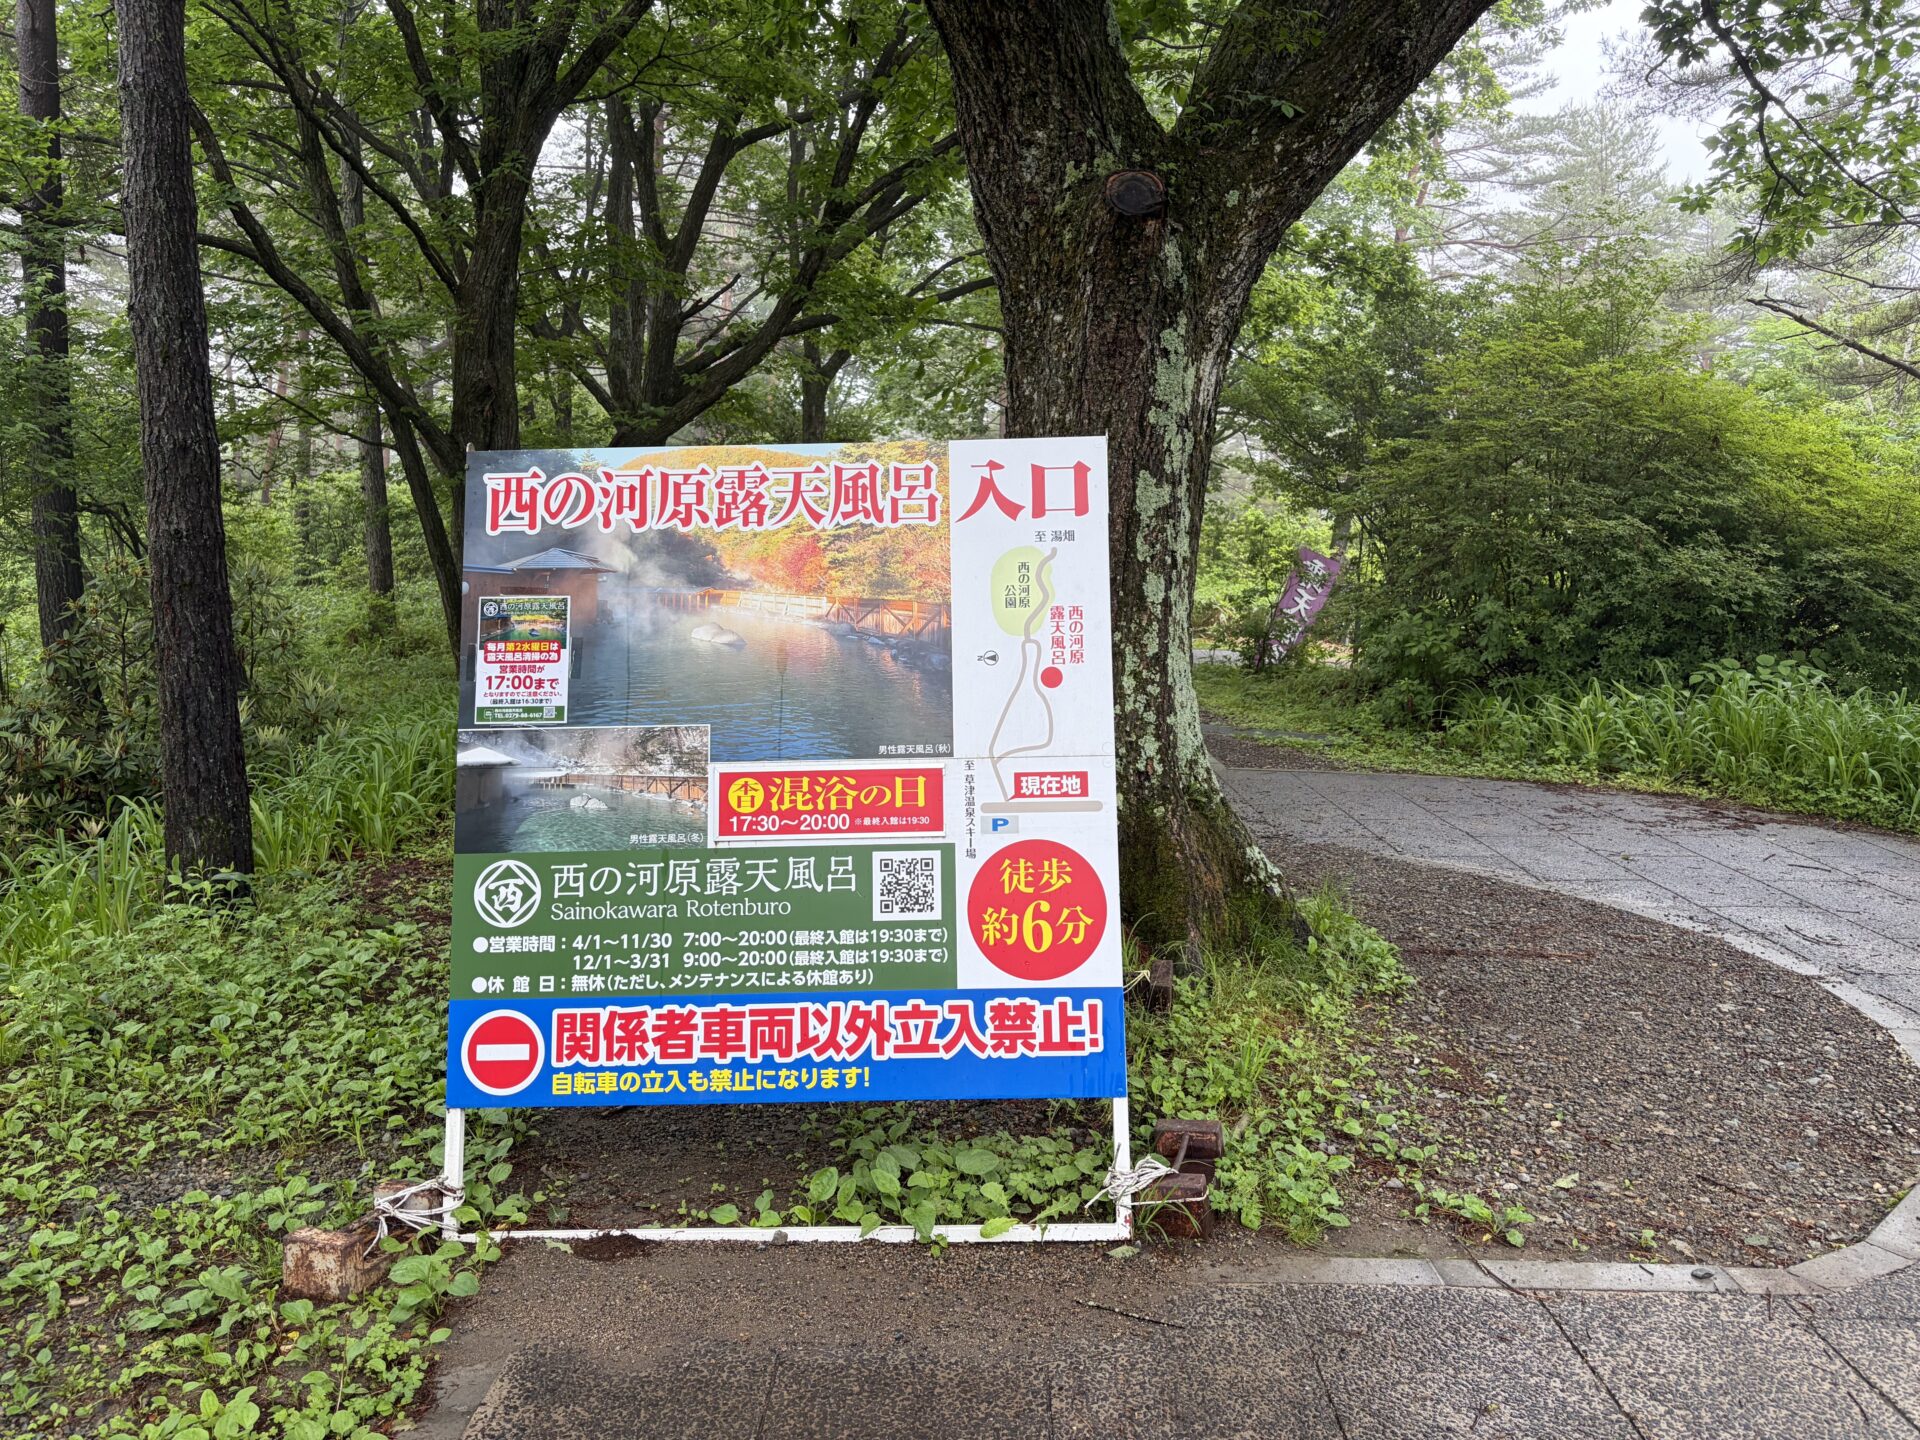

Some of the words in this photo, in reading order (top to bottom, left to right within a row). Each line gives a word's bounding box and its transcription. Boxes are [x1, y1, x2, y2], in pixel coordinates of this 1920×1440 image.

[484, 461, 940, 533] 西の河原露天風呂
[955, 459, 1092, 523] 入口
[1034, 530, 1047, 542] 至
[1050, 530, 1076, 542] 湯畑
[1004, 584, 1017, 609] 公園
[1018, 561, 1031, 609] 西の河原
[1050, 606, 1066, 665] 露天風呂
[1069, 605, 1085, 664] 西の河原
[485, 675, 560, 690] 17:00まで
[499, 665, 545, 674] 営業時間が
[878, 744, 952, 755] 男性露天風呂（秋）
[964, 760, 975, 771] 至
[768, 775, 927, 812] 混浴の日
[1020, 775, 1082, 796] 現在地
[729, 813, 850, 832] 17:30～20:00
[964, 774, 976, 859] 草津温泉スキー場
[991, 818, 1010, 832] P
[629, 832, 704, 845] 男性露天風呂（冬）
[550, 855, 857, 899] 西の河原露天風呂
[1000, 857, 1073, 895] 徒歩
[550, 903, 678, 921] Sainokawara
[686, 899, 792, 918] Rotenburo
[981, 900, 1094, 953] 約6分
[554, 1001, 1101, 1065] 関係者車両以外立入禁止!
[551, 1067, 870, 1095] 自転車の立入も禁止になります!
